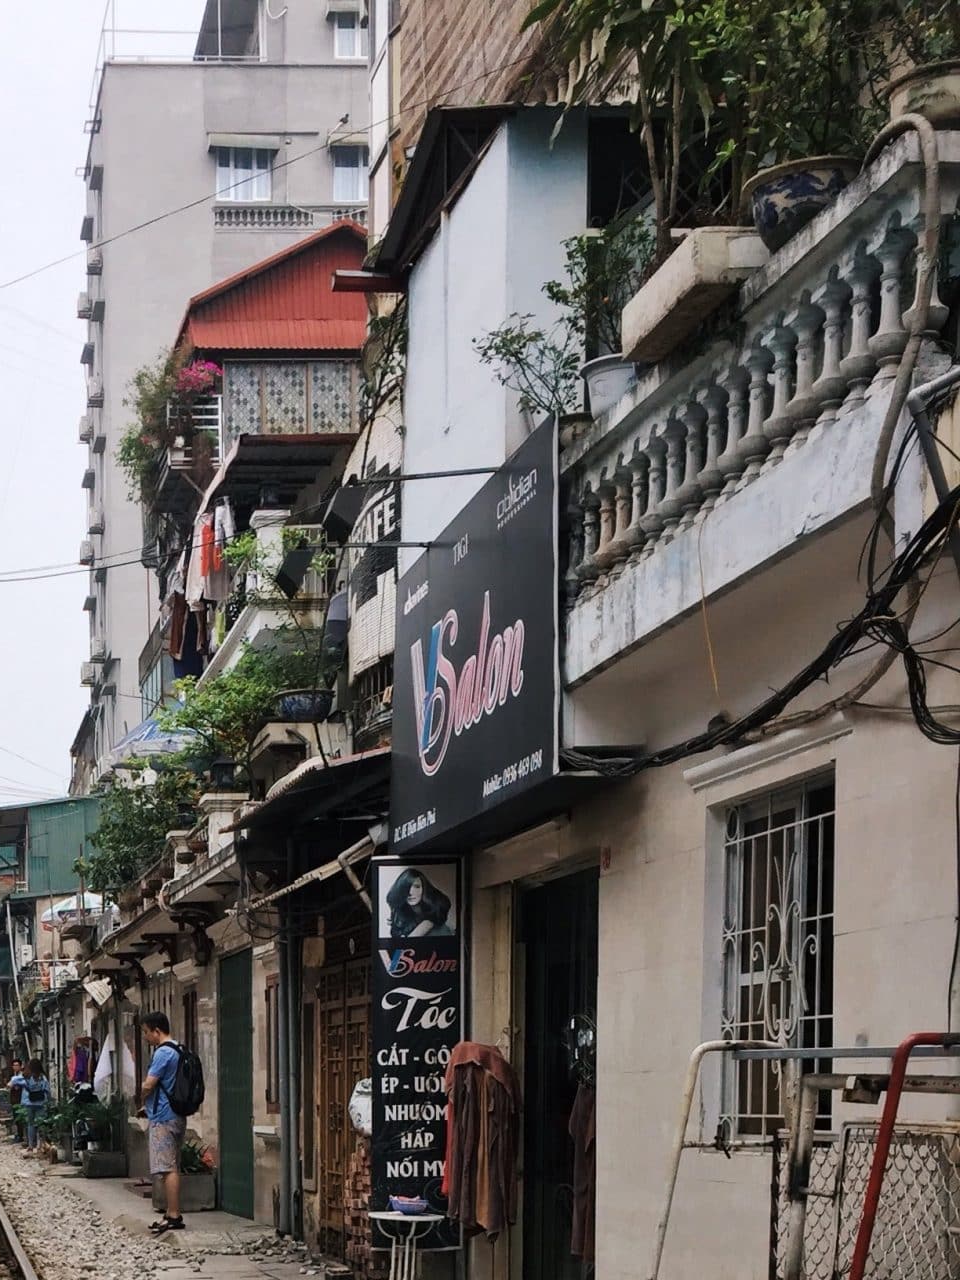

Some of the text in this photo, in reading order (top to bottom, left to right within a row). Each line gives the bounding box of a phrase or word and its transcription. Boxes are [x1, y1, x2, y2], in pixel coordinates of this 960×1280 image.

[453, 533, 469, 566] TIGI
[381, 987, 457, 1032] Tóc
[377, 1042, 410, 1066] CẮT
[424, 1045, 452, 1069] GỘ
[381, 1073, 400, 1094] ÉP
[401, 1127, 435, 1150] HẤP
[386, 1156, 419, 1178] NỐI
